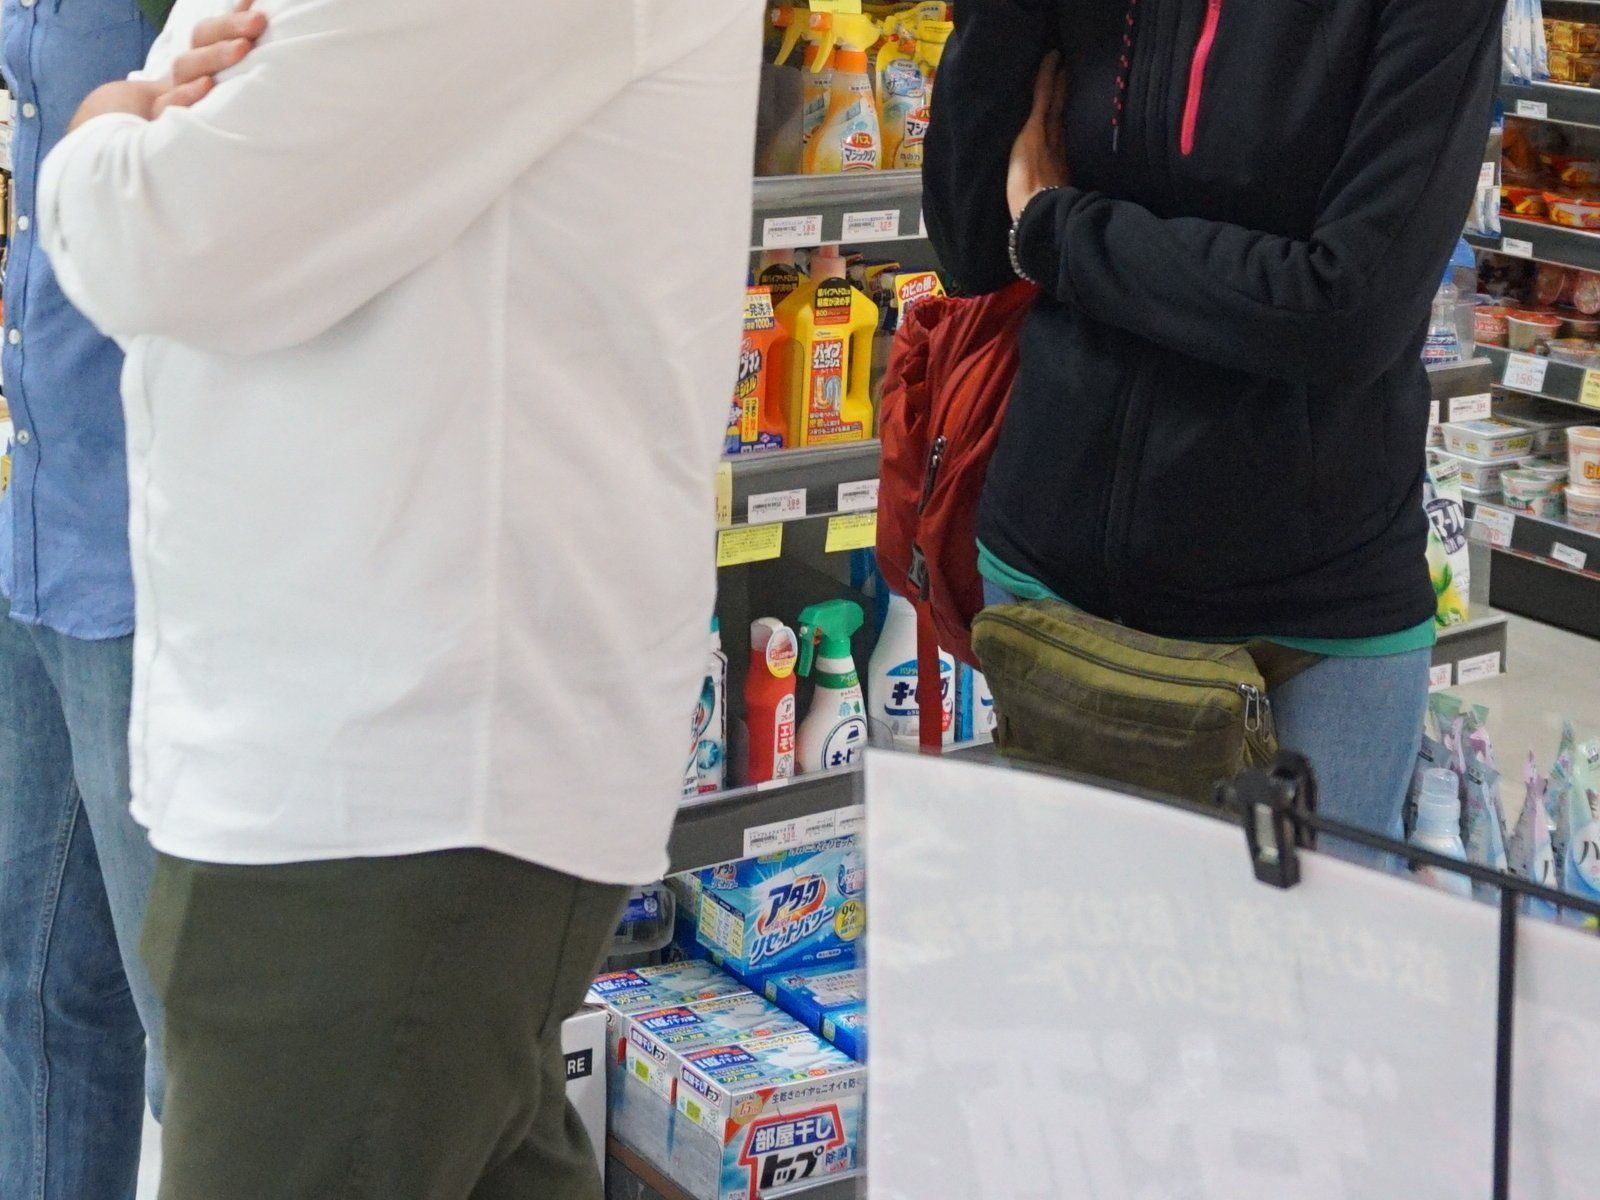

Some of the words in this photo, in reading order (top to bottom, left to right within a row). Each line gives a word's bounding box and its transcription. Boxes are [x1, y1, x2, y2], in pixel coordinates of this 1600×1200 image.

[765, 878, 822, 928] アタック
[749, 907, 835, 966] リセットパワー
[755, 1116, 833, 1150] 部屋干し
[759, 1145, 825, 1189] トップ
